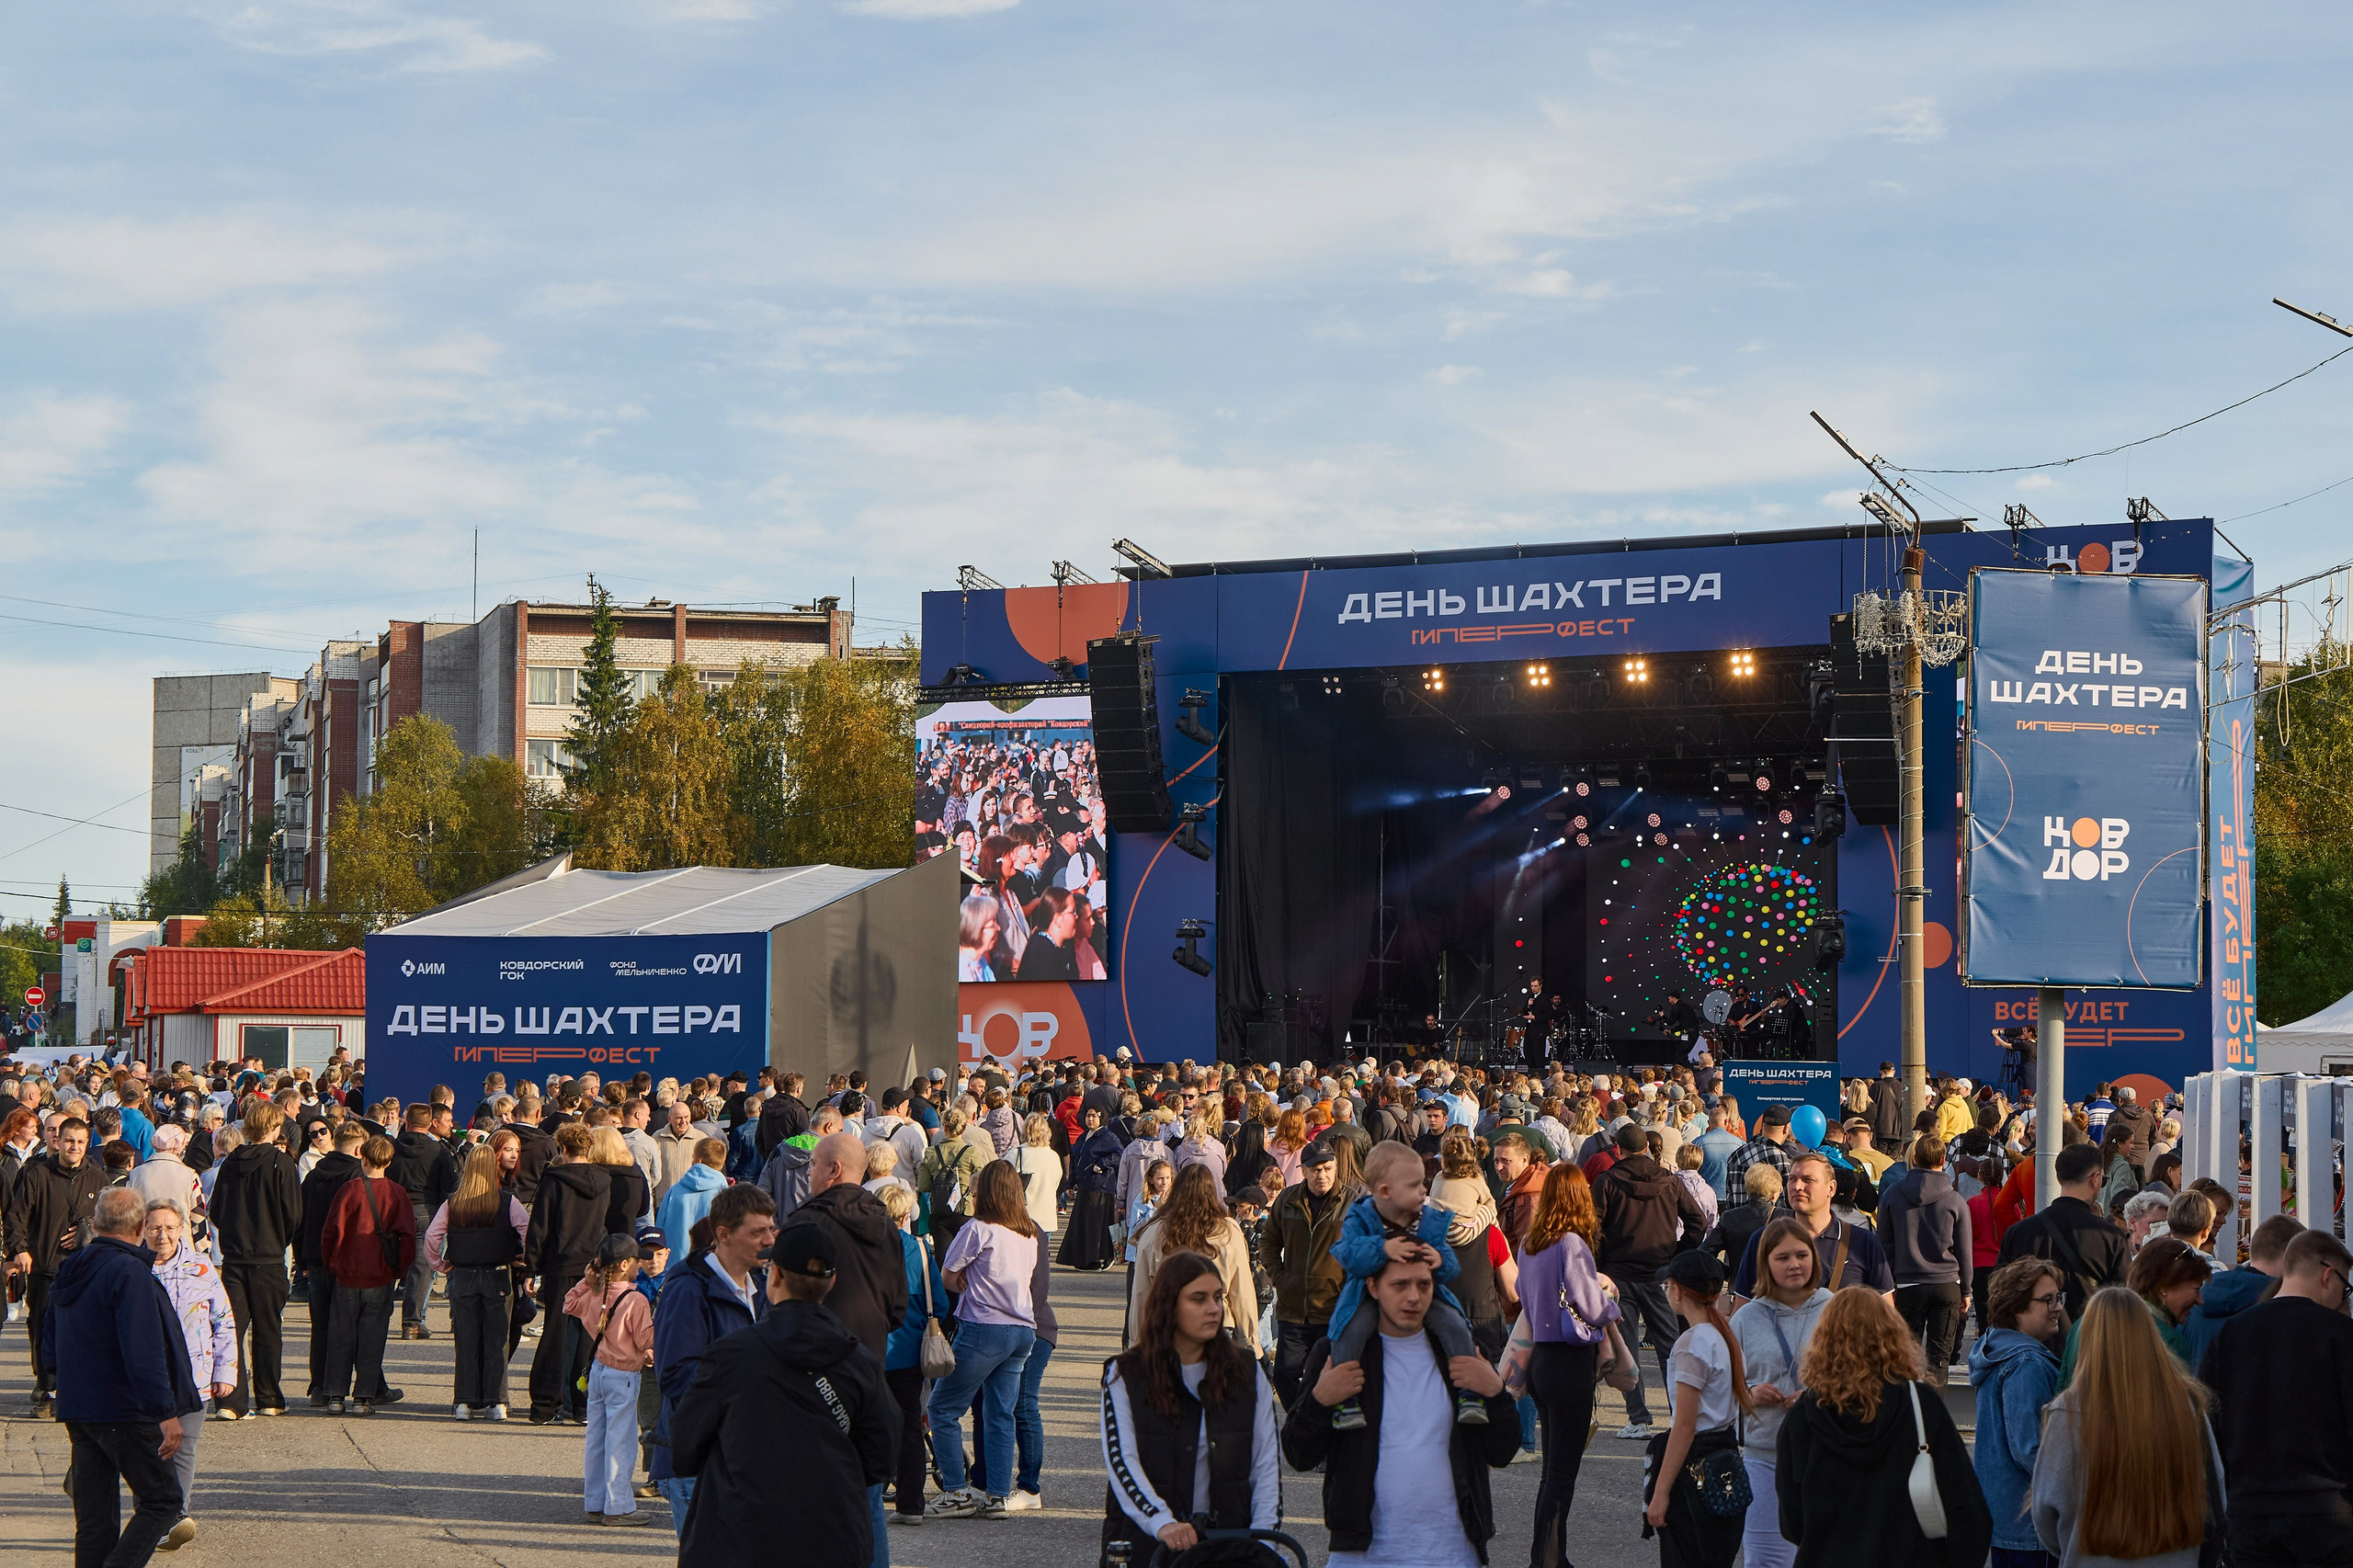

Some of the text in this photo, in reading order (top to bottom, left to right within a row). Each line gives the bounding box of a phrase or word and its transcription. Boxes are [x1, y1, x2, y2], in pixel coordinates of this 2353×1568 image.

[1338, 573, 1722, 624] ДЕНЬ ШАХТЕРА
[2035, 650, 2143, 676] ДЕНЬ
[1990, 680, 2187, 710] ШАХТЕРА
[2220, 814, 2241, 1063] ВСЁ БУДЕТ
[416, 962, 446, 975] АИМ
[500, 960, 584, 971] КОВДОРСКИЙ
[500, 971, 525, 980] ГОК
[615, 968, 688, 976] МЕЛЬНИЧЕНКО
[387, 1004, 741, 1037] ДЕНЬ ШАХТЕРА
[2063, 1002, 2129, 1024] УДЕТ
[1729, 1069, 1832, 1079] ДЕНЬ ШАХТЕРА
